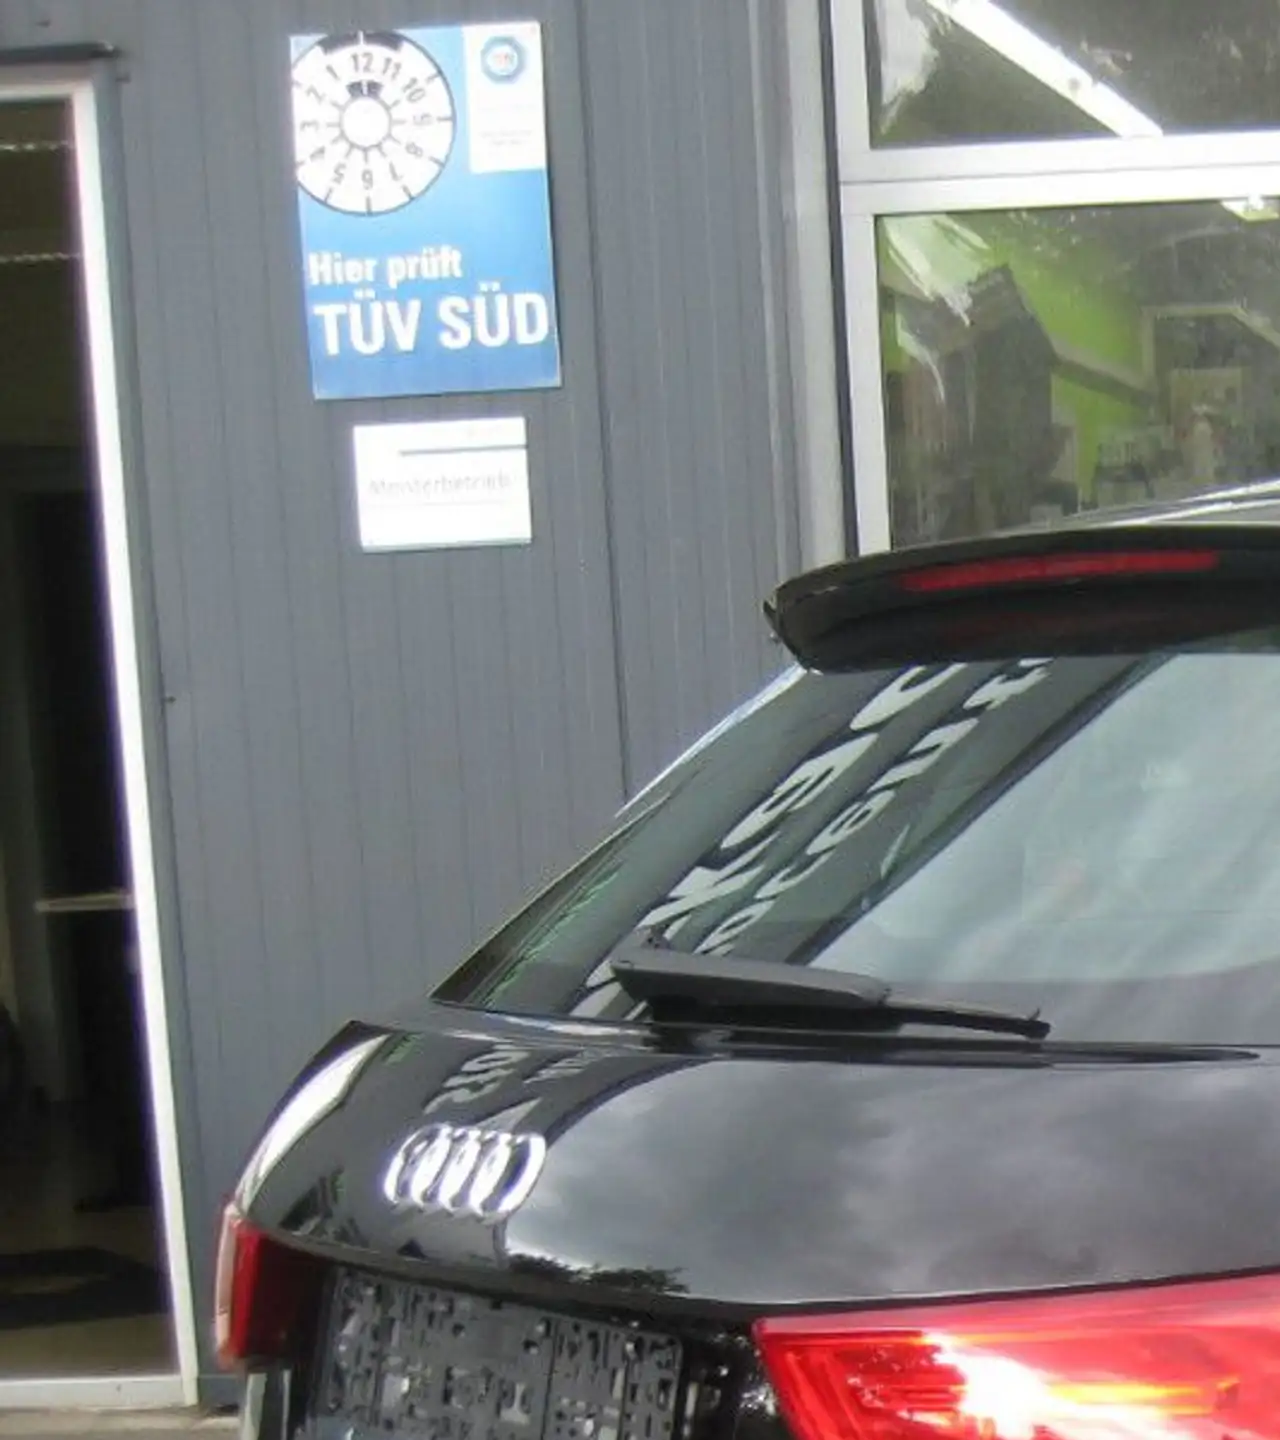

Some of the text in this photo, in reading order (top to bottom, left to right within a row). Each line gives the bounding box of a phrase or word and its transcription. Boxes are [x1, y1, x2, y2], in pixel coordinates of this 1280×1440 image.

[352, 52, 374, 73] 12
[382, 57, 402, 81] 11
[402, 77, 427, 103] 10
[308, 245, 462, 289] Hier prüft
[313, 281, 549, 356] TÜV SÜD
